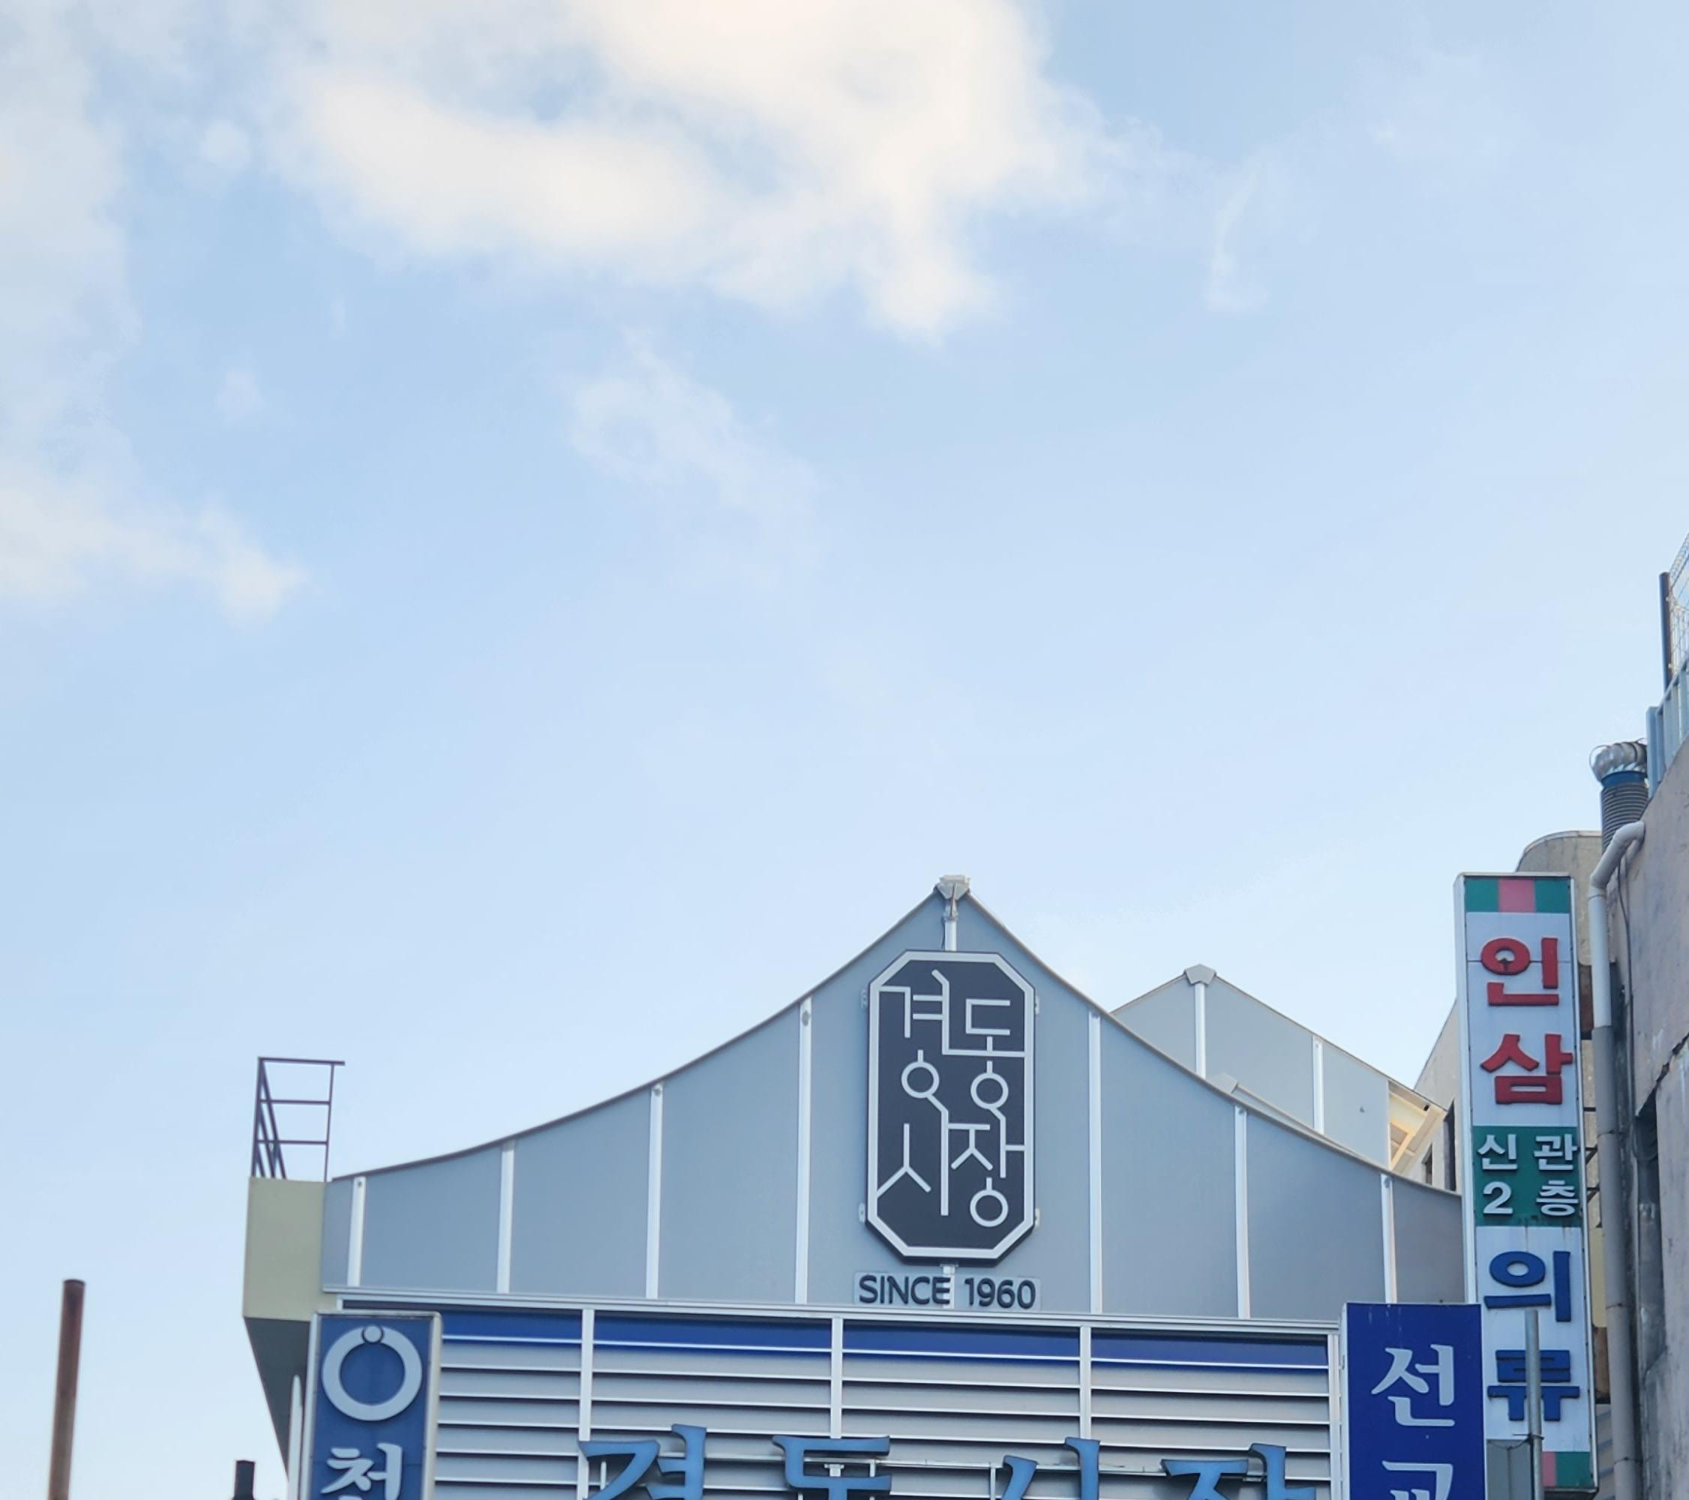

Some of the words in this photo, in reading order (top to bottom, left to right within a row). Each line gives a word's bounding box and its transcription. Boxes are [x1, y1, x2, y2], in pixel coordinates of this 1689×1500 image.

[1480, 937, 1573, 1106] 인삼
[858, 1274, 951, 1305] SINCE
[964, 1276, 1037, 1309] 1960
[1484, 1250, 1580, 1422] 의류
